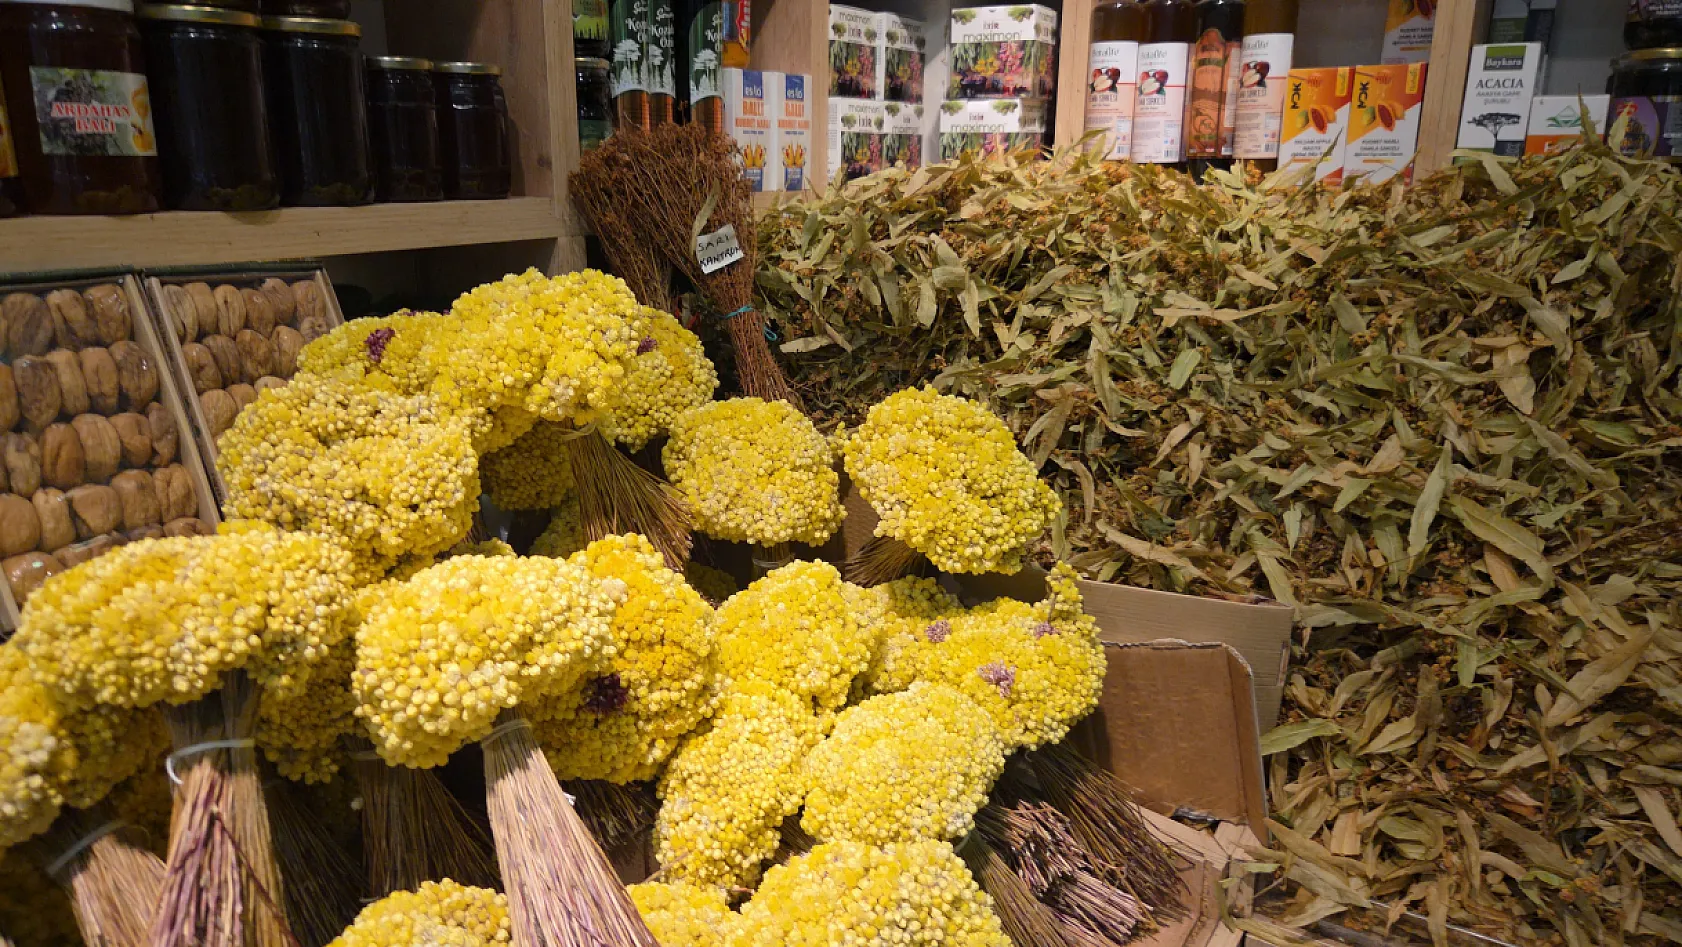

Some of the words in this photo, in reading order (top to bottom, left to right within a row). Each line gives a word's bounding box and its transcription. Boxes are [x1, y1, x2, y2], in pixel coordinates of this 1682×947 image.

[1475, 78, 1524, 89] ACACIA
[51, 101, 131, 118] ARDAHAN
[75, 118, 117, 133] BALI
